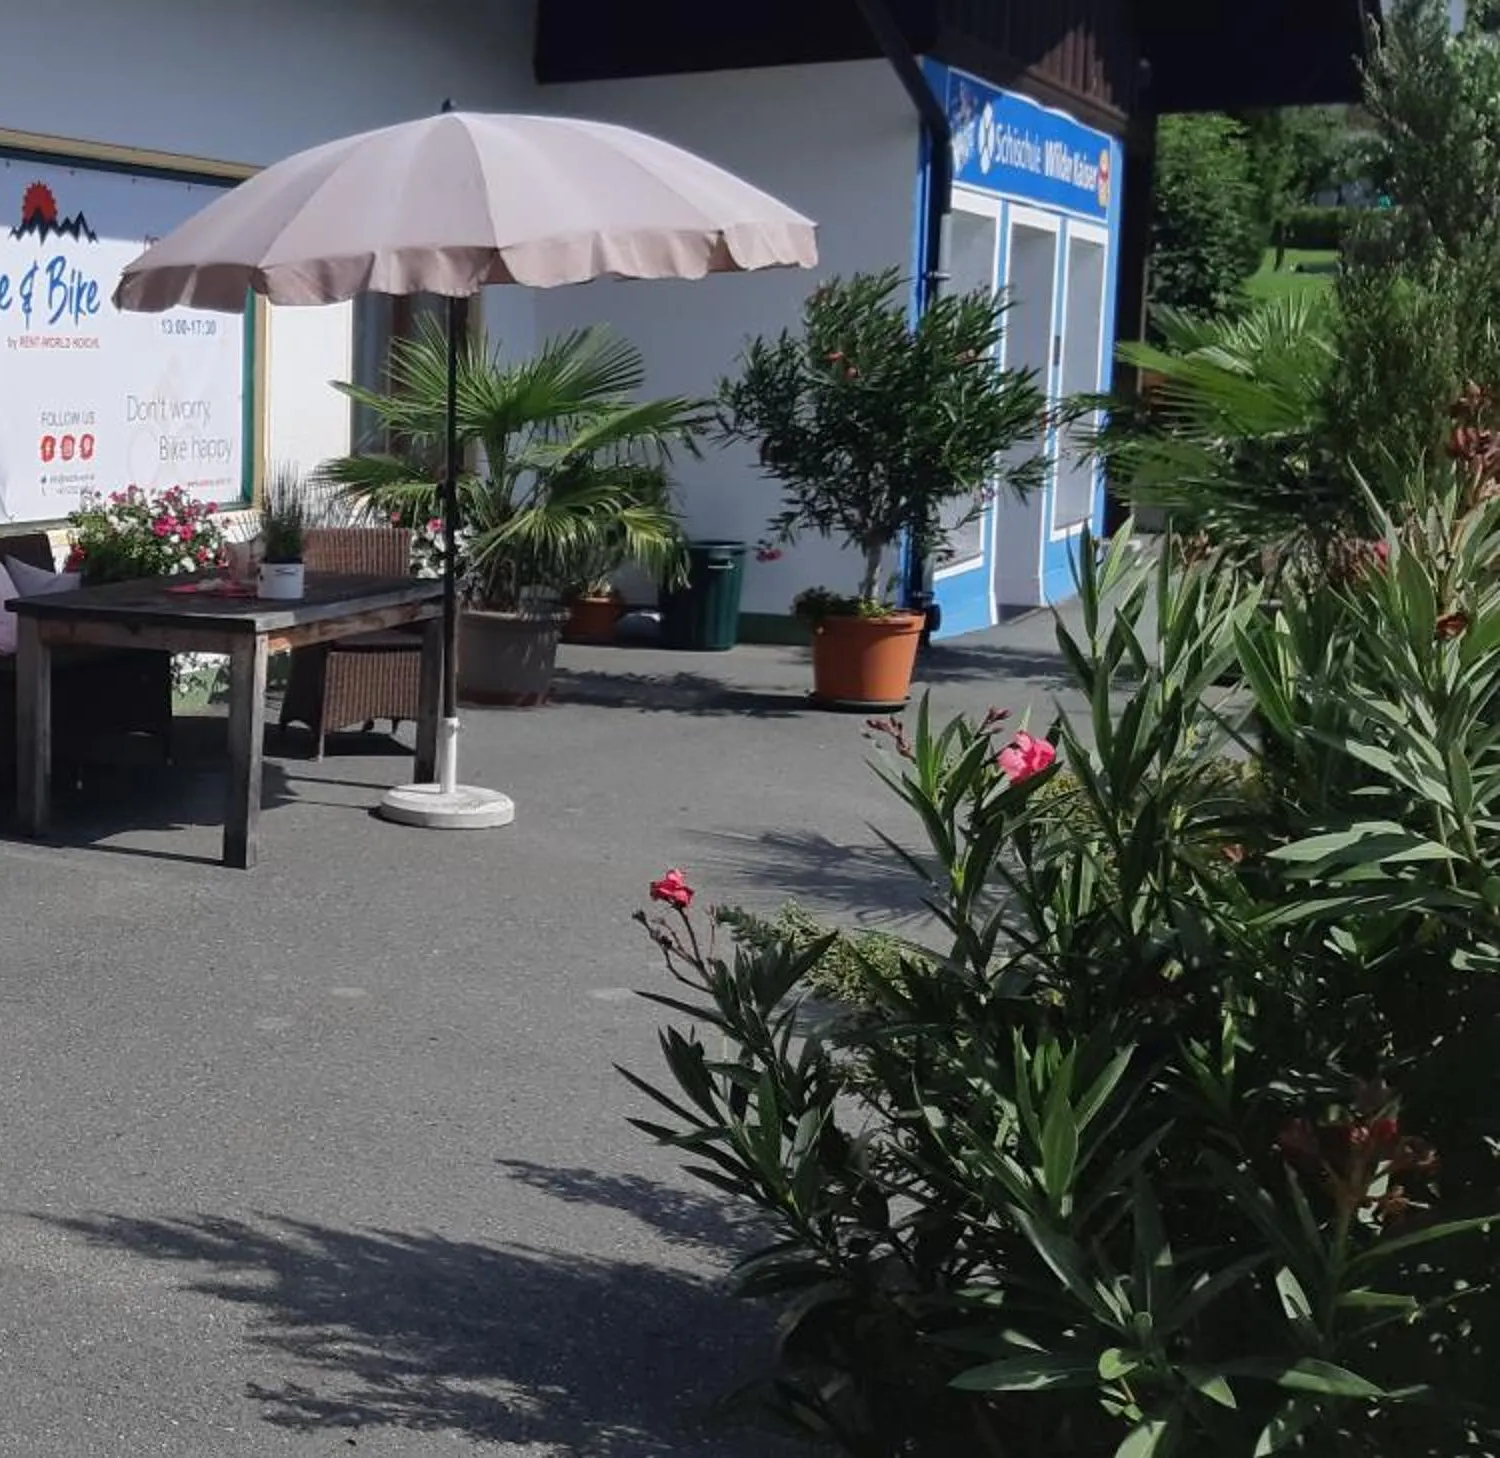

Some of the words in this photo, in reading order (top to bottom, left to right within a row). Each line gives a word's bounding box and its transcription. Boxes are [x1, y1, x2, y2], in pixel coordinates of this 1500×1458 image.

[995, 122, 1042, 175] Schischule
[19, 259, 40, 330] &
[46, 255, 100, 328] Bike
[40, 410, 80, 427] FOLLOW
[81, 410, 96, 426] US
[126, 394, 166, 422] Don't
[158, 434, 188, 461] Bike
[191, 435, 232, 466] happy
